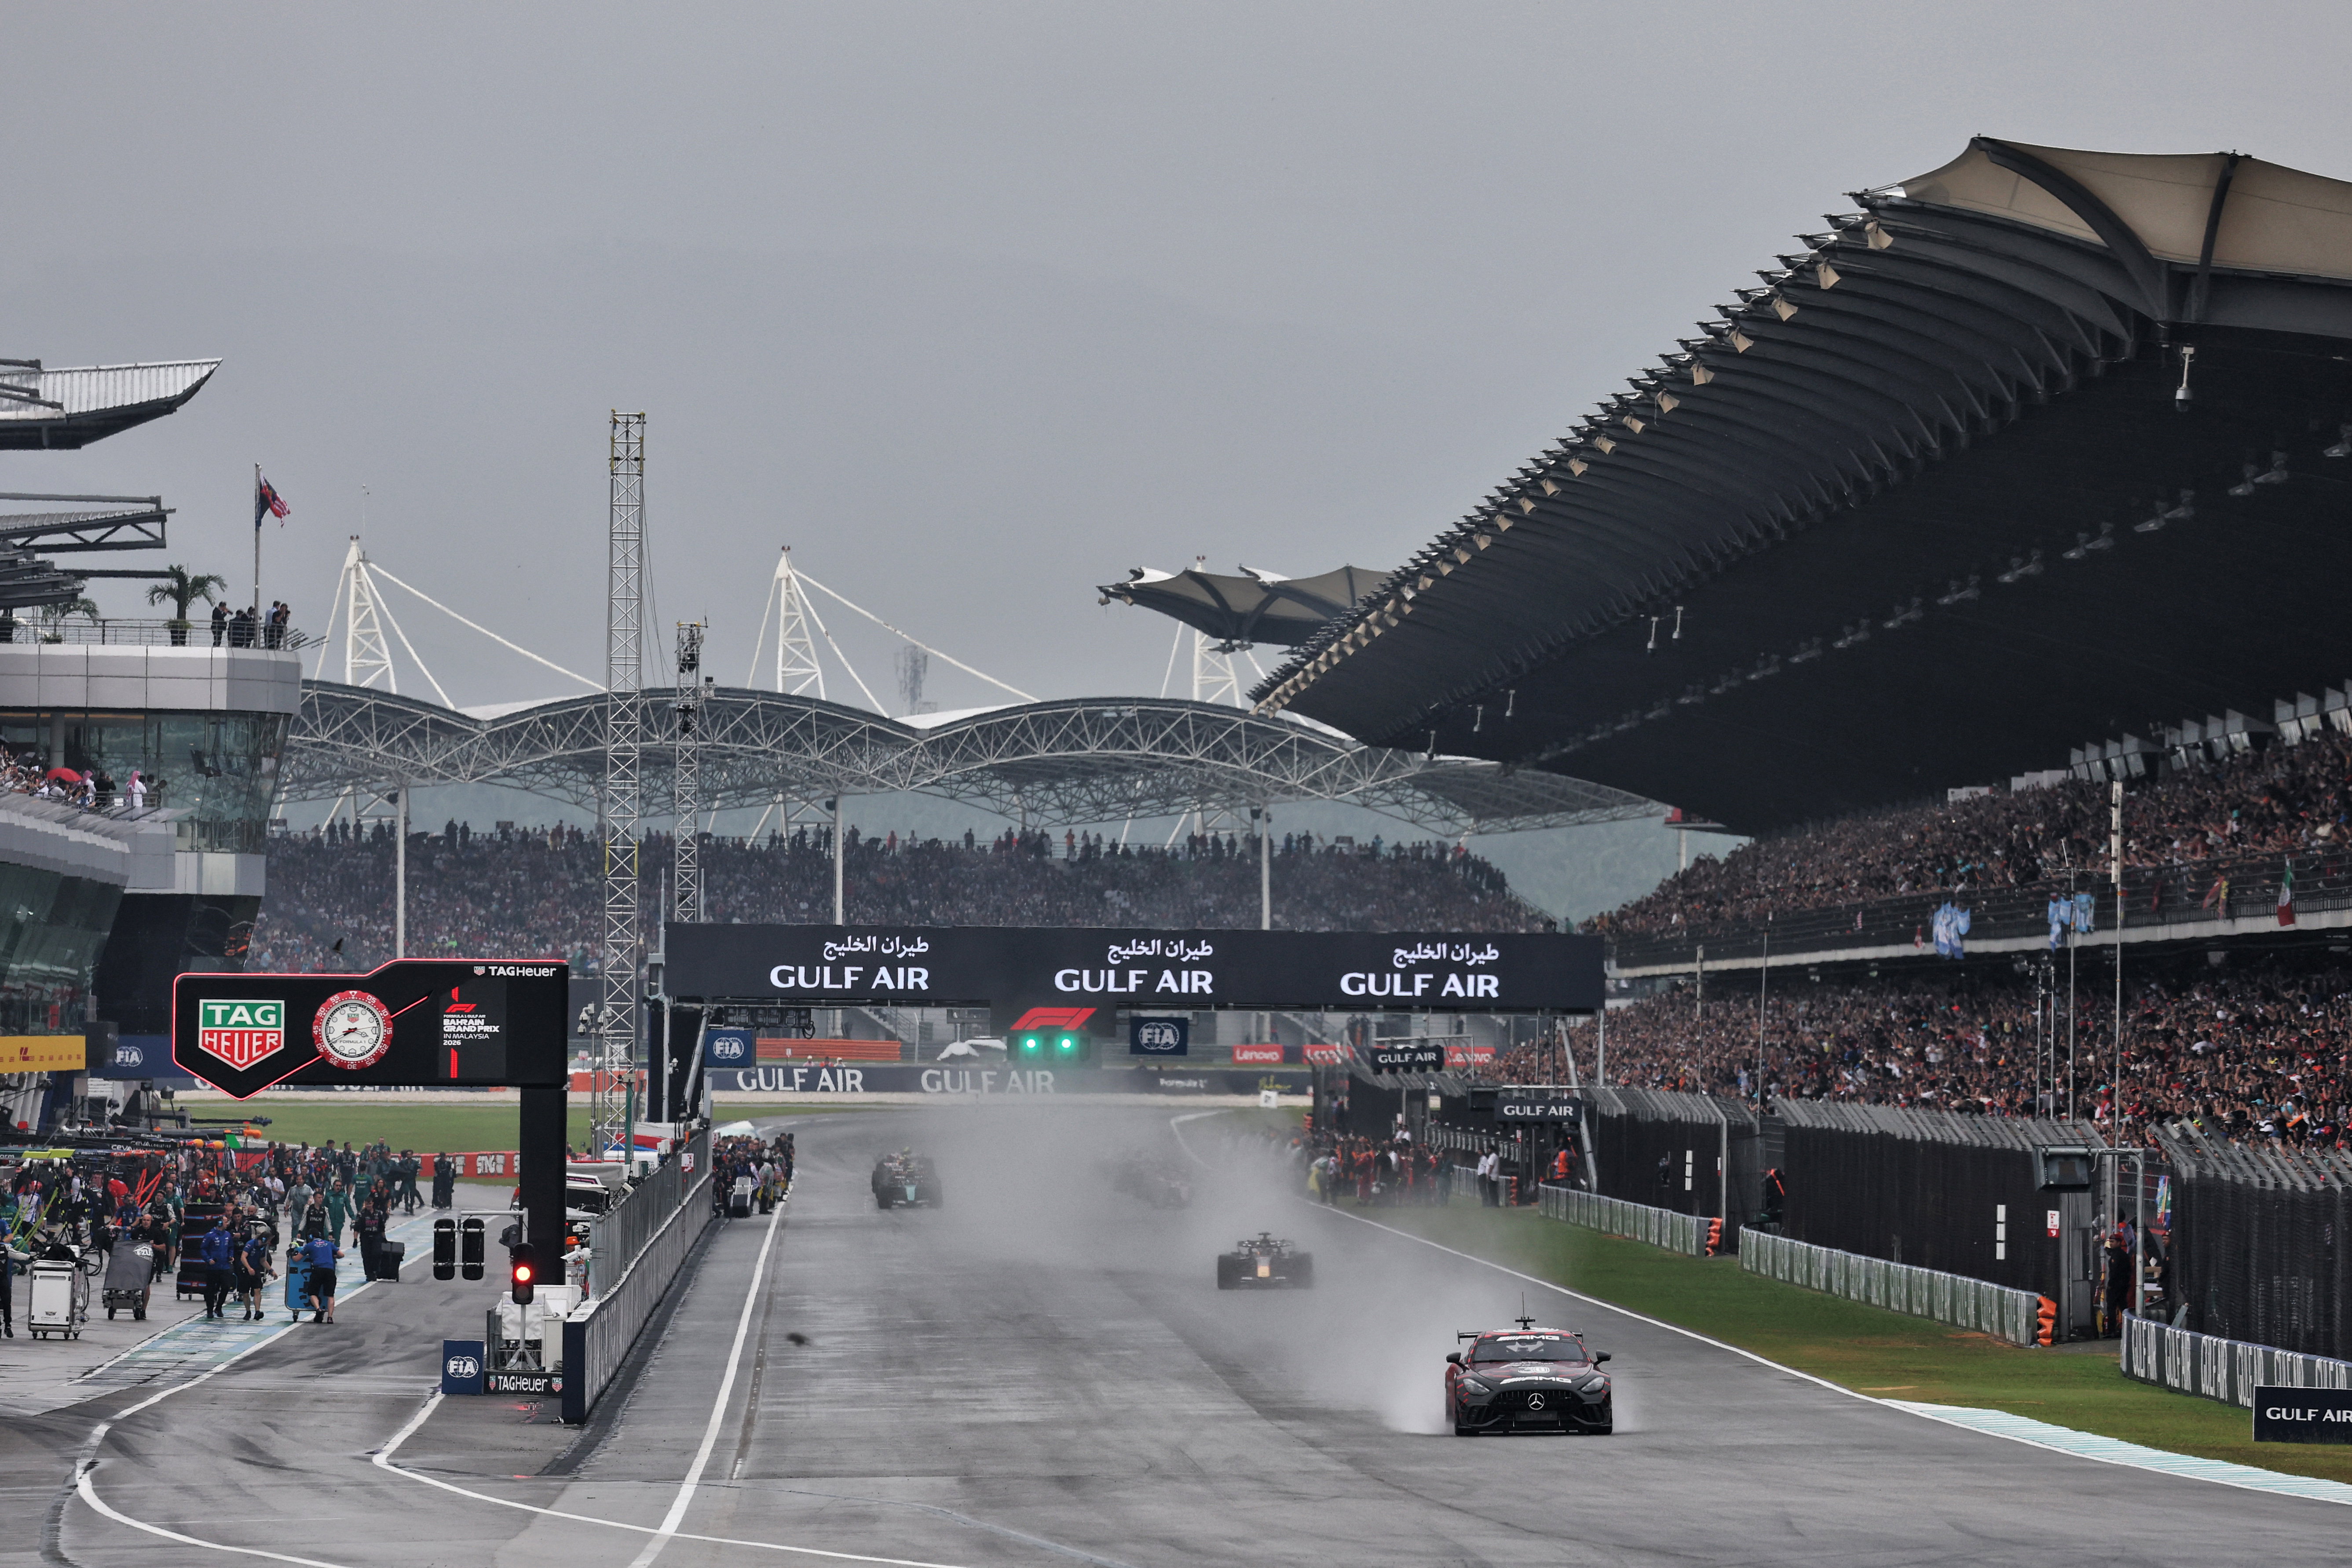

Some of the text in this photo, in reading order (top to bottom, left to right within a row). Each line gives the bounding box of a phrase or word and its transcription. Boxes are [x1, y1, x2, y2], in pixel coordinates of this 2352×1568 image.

[823, 935, 929, 961] طيران الخليج
[1108, 939, 1213, 965] طيران الخليج
[1393, 942, 1500, 969] طيران الخليج
[770, 965, 929, 990] GULF AIR
[1054, 969, 1213, 994] GULF AIR
[1340, 972, 1499, 998] GULF AIR
[207, 1005, 276, 1025] TAG
[205, 1032, 278, 1065] HEUER
[1236, 1049, 1280, 1061] Lenovo
[1378, 1052, 1437, 1064] GULF AIR
[737, 1068, 864, 1092] GULF AIR
[921, 1069, 1055, 1093] GULF AIR
[1503, 1105, 1573, 1116] GULF AIR
[2266, 1407, 2352, 1423] GULF AIR
